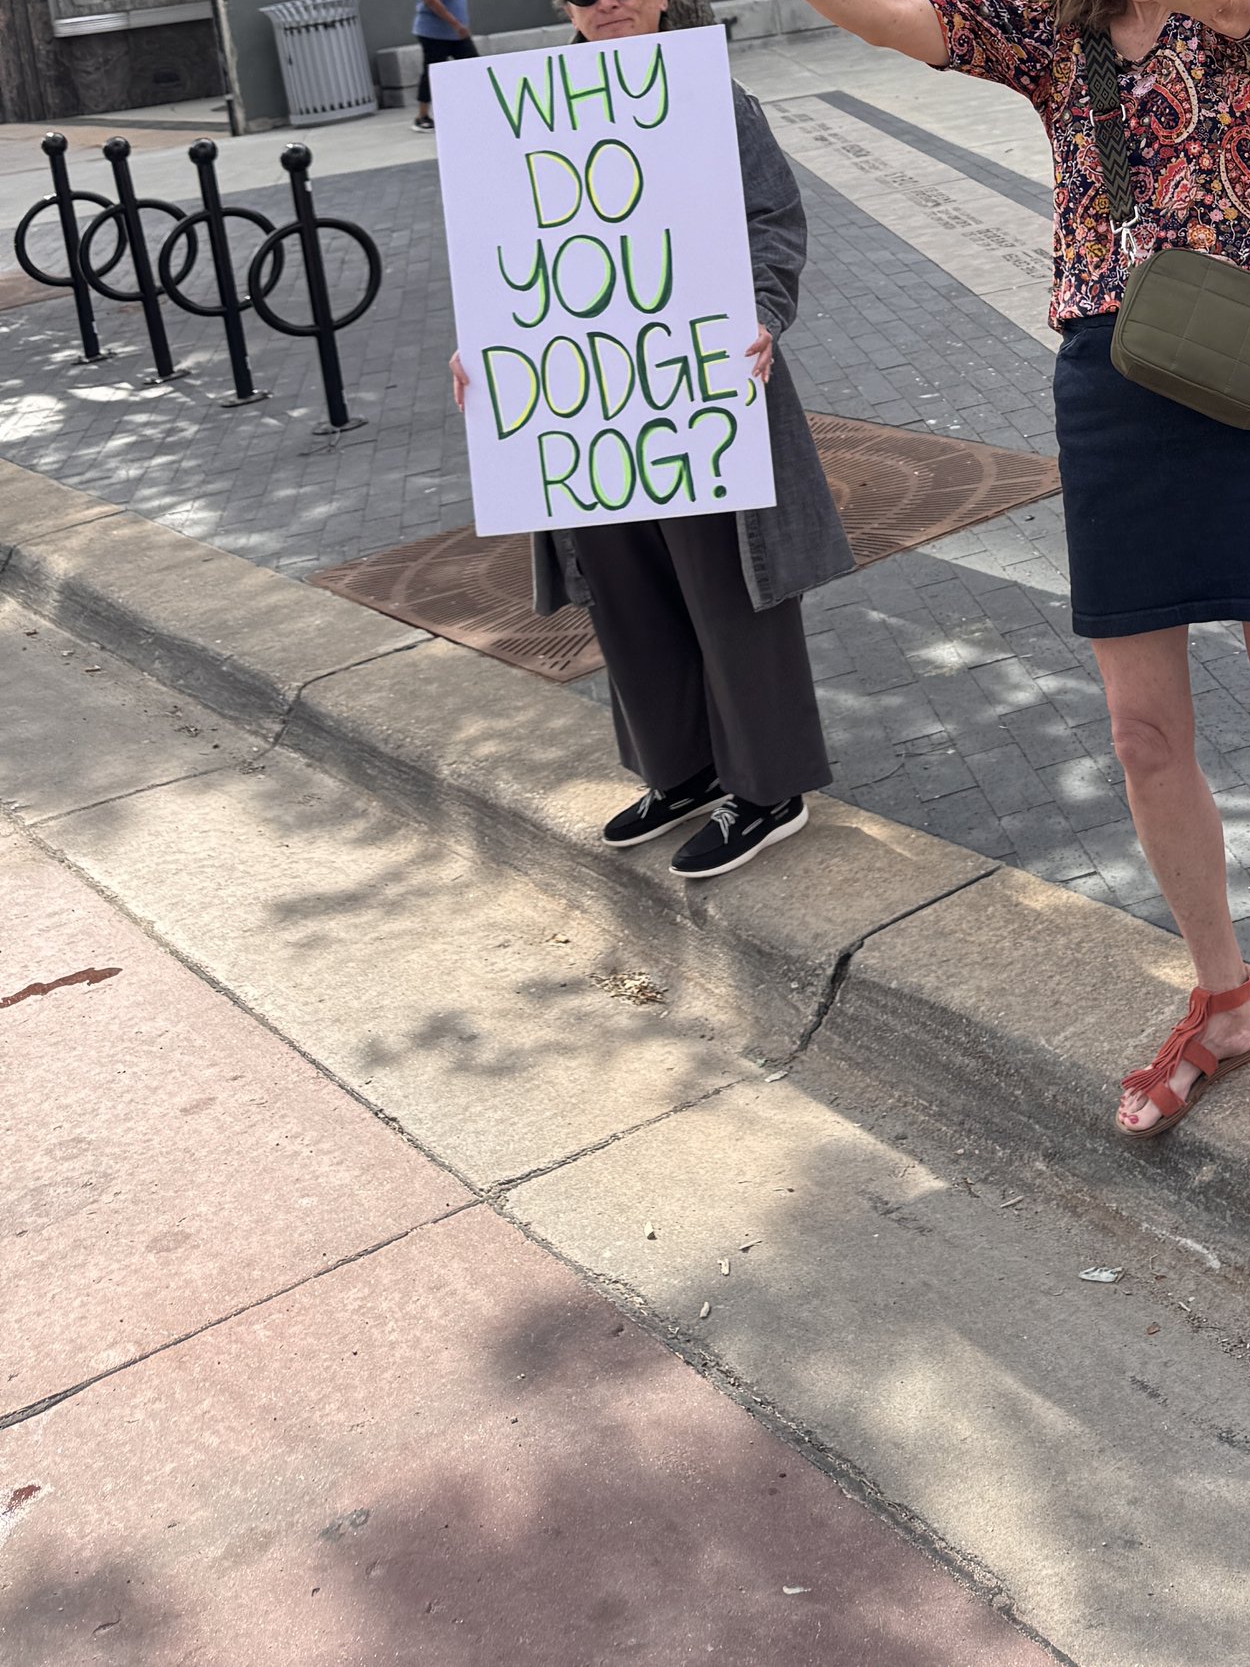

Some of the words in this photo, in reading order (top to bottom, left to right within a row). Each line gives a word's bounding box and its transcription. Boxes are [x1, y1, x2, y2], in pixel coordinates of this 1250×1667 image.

[486, 42, 670, 140] WHY
[525, 138, 644, 229] DO
[496, 228, 674, 329] YOU
[481, 313, 757, 441] DODGE,
[537, 407, 738, 518] ROG?
